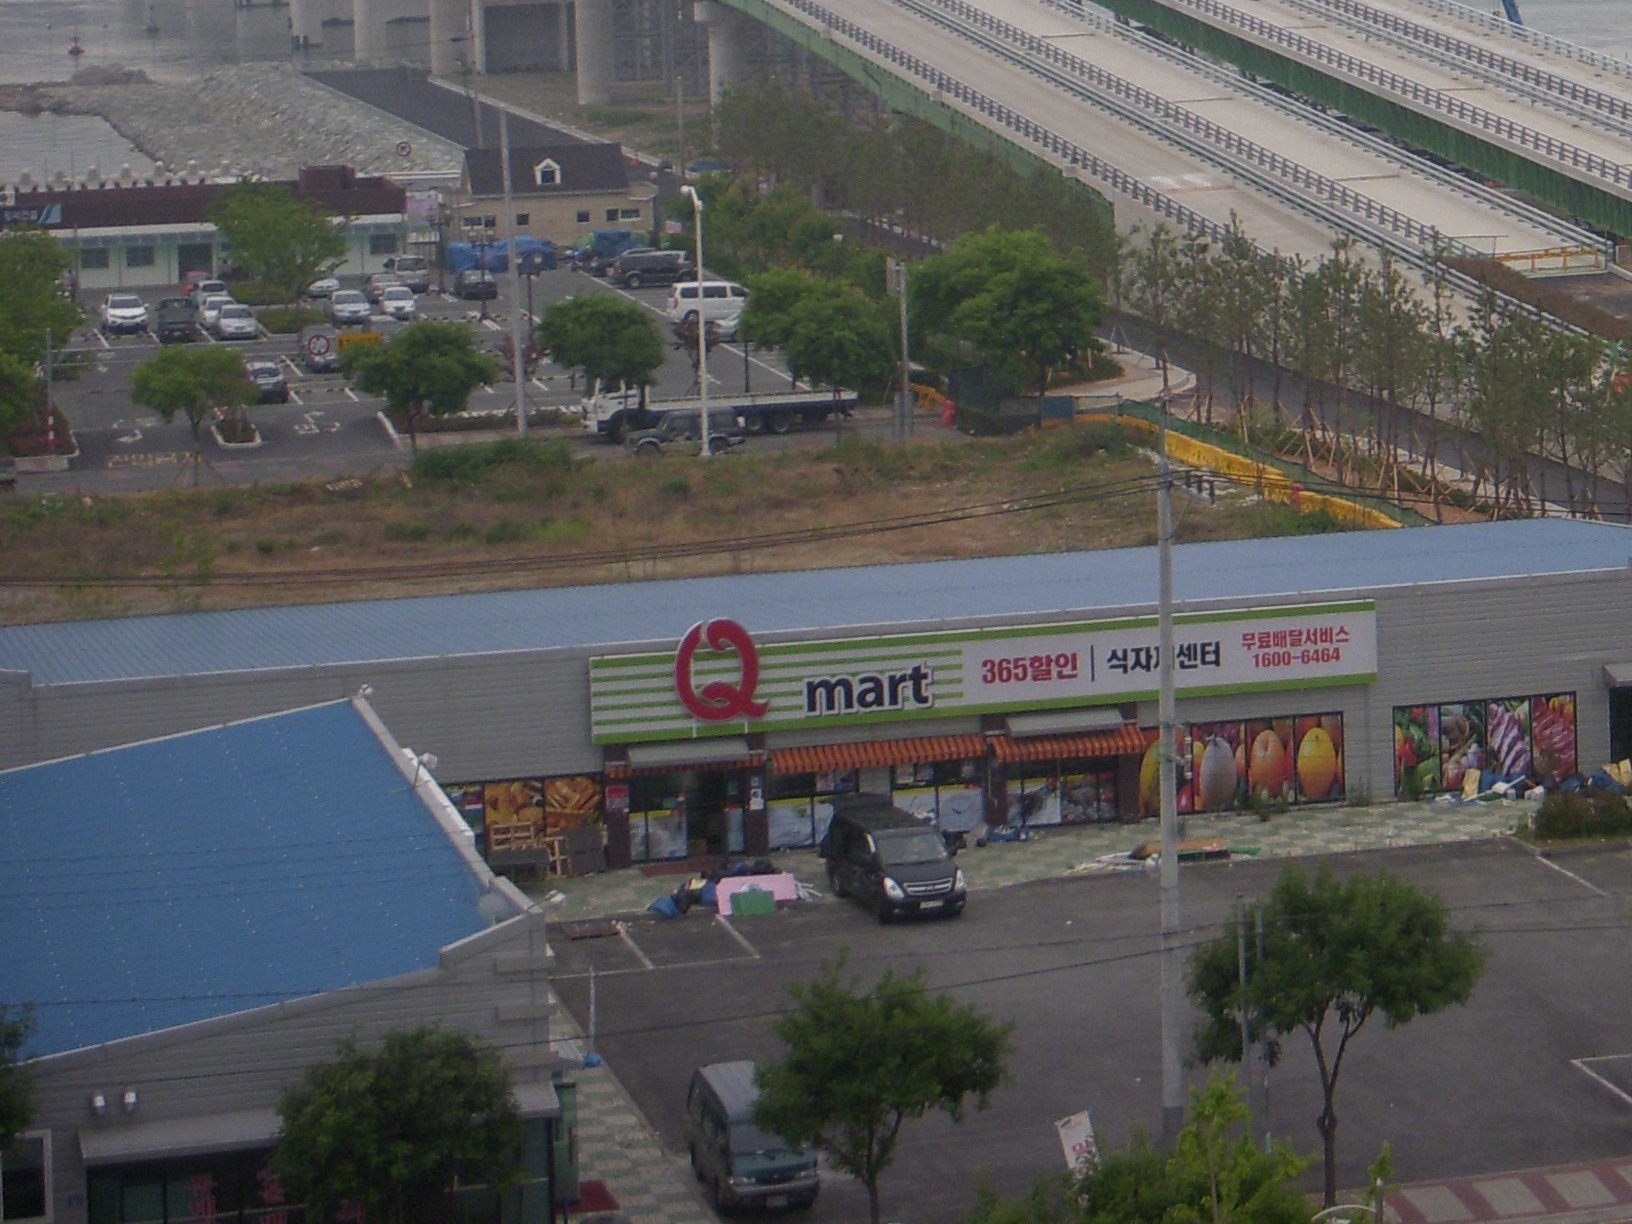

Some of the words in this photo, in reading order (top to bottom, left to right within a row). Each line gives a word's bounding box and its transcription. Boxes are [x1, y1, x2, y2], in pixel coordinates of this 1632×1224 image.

[1242, 626, 1350, 651] 무료배달서비스
[675, 618, 769, 722] Q
[807, 664, 933, 714] mart
[981, 652, 1078, 684] 365할인
[1106, 640, 1221, 674] 식자센터
[1252, 647, 1341, 668] 1600-6464
